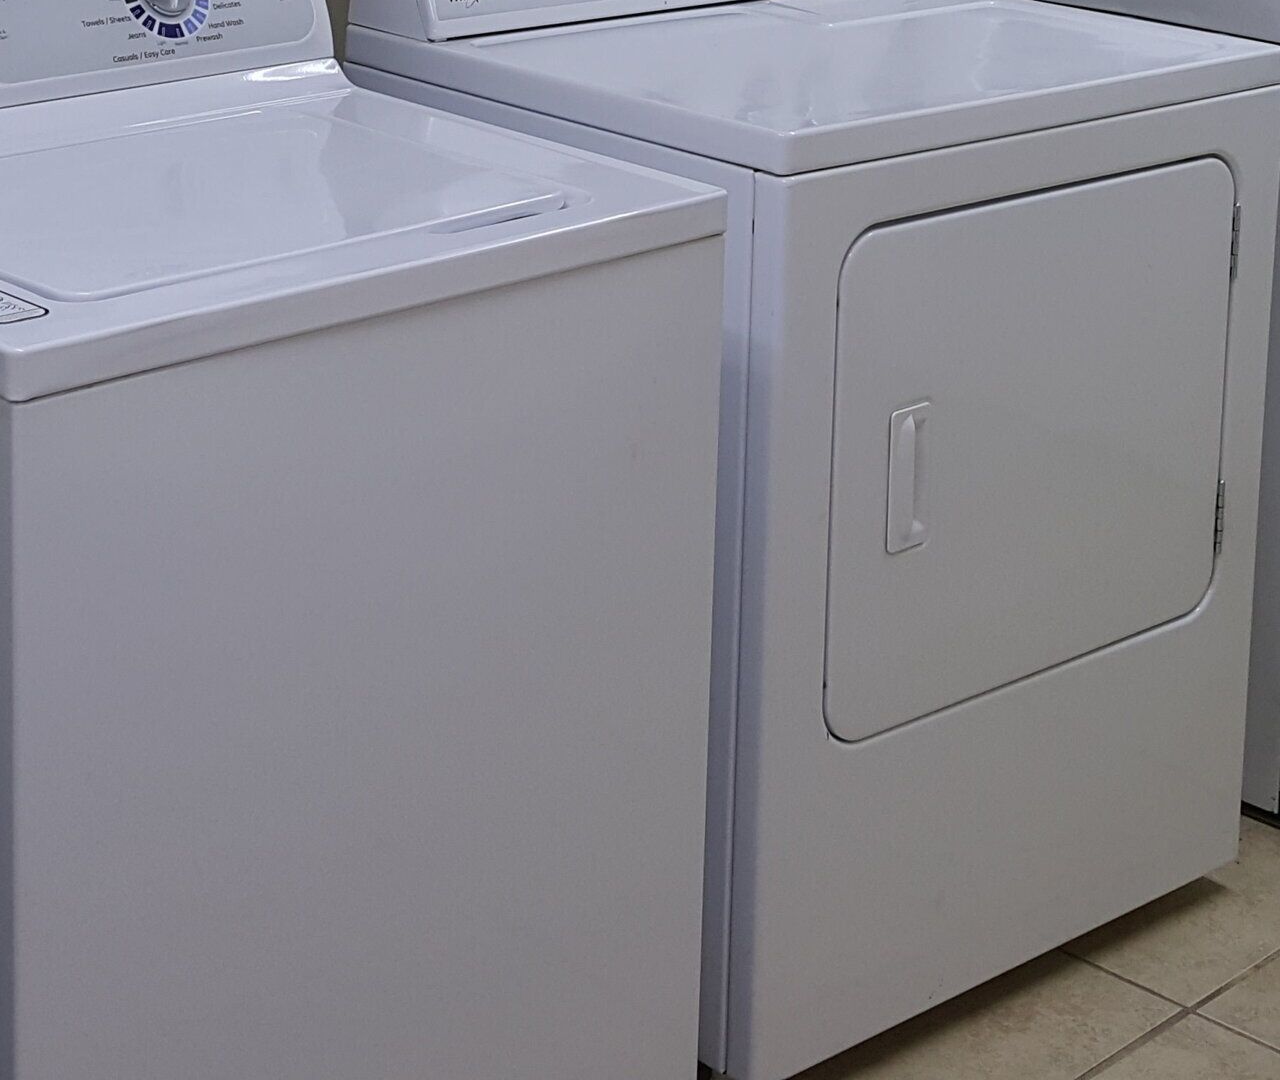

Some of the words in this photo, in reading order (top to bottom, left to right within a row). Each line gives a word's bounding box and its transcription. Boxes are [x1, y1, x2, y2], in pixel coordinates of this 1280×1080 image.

[213, 1, 242, 10] Delicates
[82, 18, 104, 27] Towels
[128, 32, 147, 40] Jeans
[196, 33, 223, 42] Prewash
[113, 53, 139, 63] Casuals
[144, 51, 159, 59] Easy
[160, 48, 176, 56] Care
